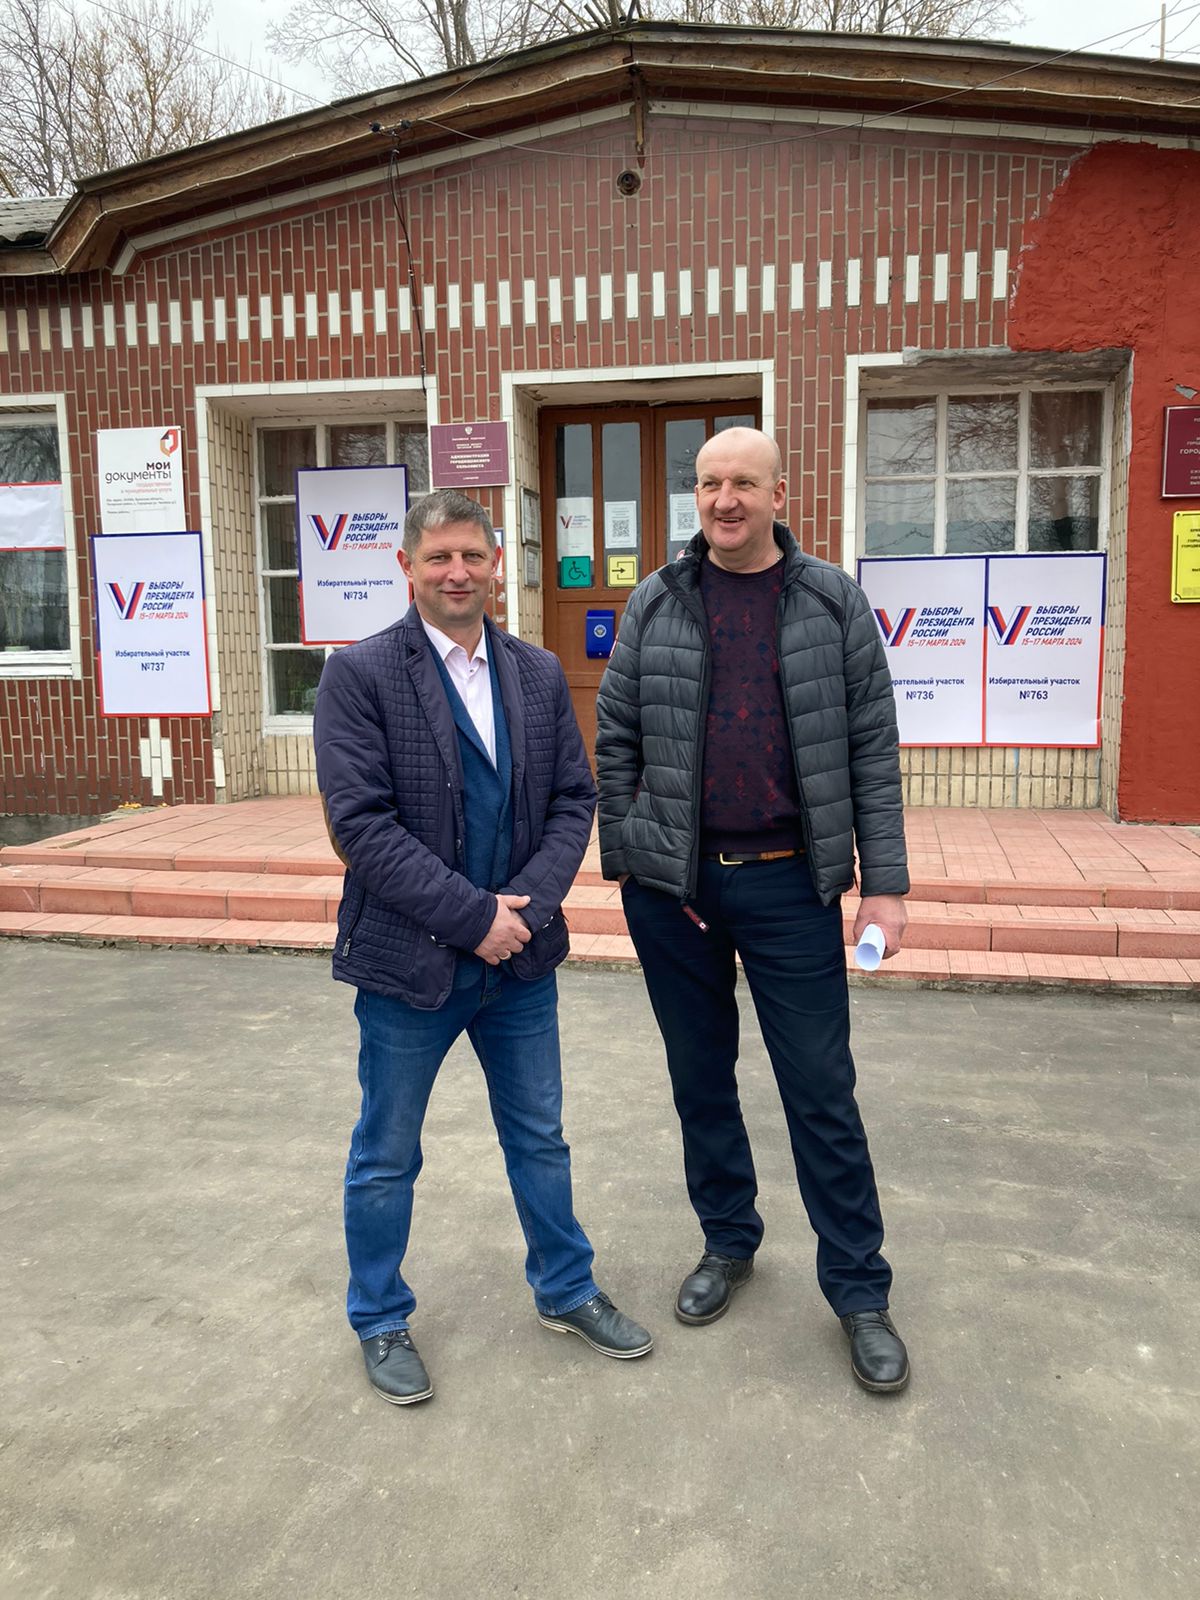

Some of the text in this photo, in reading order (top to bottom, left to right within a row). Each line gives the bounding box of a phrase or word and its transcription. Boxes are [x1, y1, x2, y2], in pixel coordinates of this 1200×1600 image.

[352, 513, 388, 521] ВЫБОРЫ
[348, 522, 398, 531] ПРЕЗИДЕНТА
[345, 533, 377, 541] РОССИИ
[148, 581, 184, 590] ВЫБОРЫ
[317, 579, 368, 587] Избирательный
[145, 591, 194, 600] ПРЕЗИДЕНТА
[344, 591, 368, 600] №734
[142, 602, 173, 610] РОССИИ
[1036, 605, 1080, 614] ВЫБОРЫ
[175, 611, 188, 619] 2024
[921, 607, 963, 616] ВЫБОРЫ
[916, 617, 975, 627] ПРЕЗИДЕНТА
[1031, 616, 1092, 625] ПРЕЗИДЕНТА
[911, 629, 949, 637] РОССИИ
[1026, 627, 1065, 636] РОССИИ
[141, 662, 165, 671] №737
[989, 677, 1080, 686] Избирательный участок
[906, 691, 934, 700] №736
[1019, 690, 1048, 700] №763
